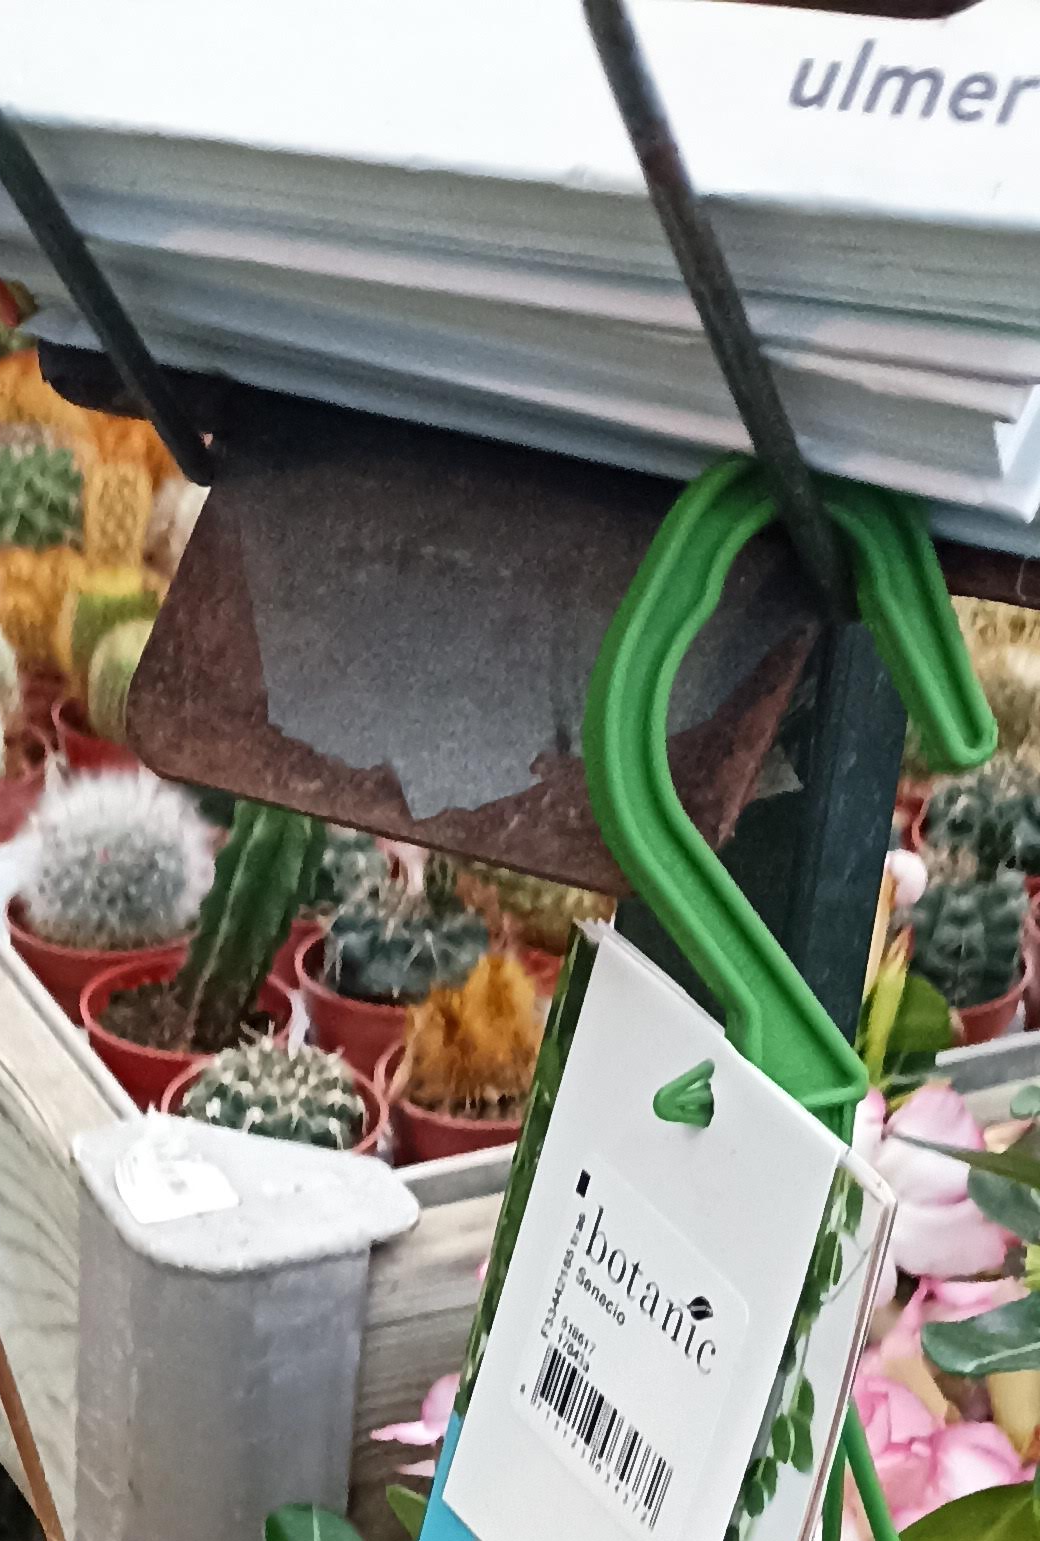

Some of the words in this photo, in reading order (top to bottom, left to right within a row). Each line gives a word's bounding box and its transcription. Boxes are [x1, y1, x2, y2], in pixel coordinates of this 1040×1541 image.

[789, 38, 1040, 127] ulmer
[575, 1266, 627, 1327] Senecio
[586, 1205, 717, 1376] botanic
